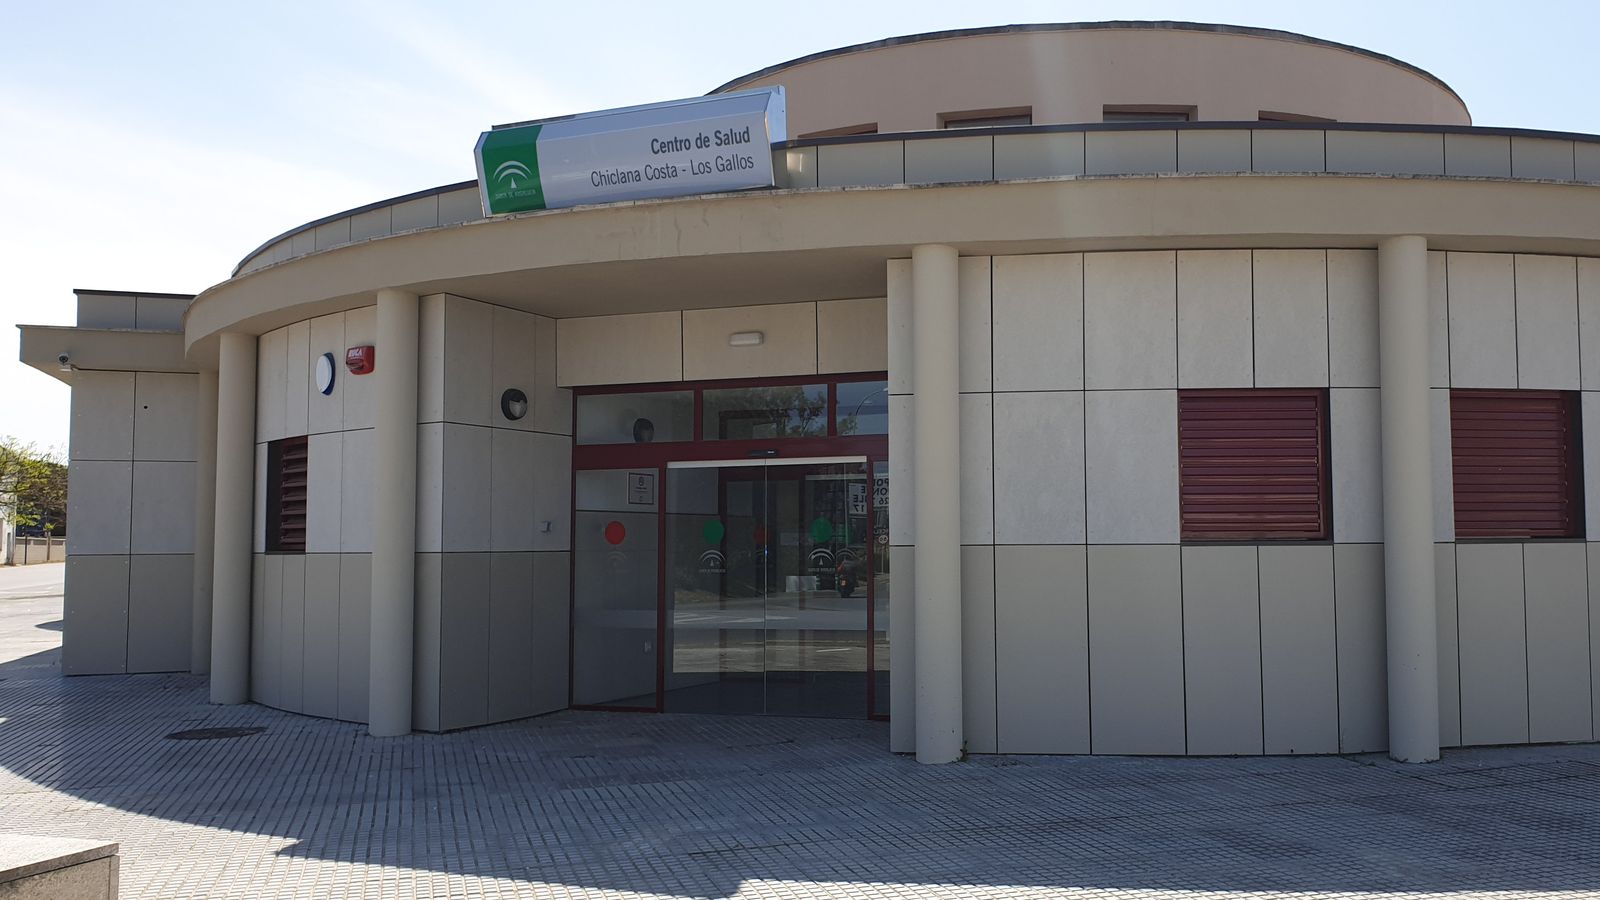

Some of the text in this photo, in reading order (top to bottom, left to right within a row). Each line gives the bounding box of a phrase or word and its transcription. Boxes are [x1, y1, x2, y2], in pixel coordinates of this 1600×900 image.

[650, 126, 751, 155] Centro de Salud
[590, 167, 642, 187] Chiclana
[644, 162, 678, 181] Costa
[690, 159, 712, 176] Los
[715, 153, 754, 173] Gallos
